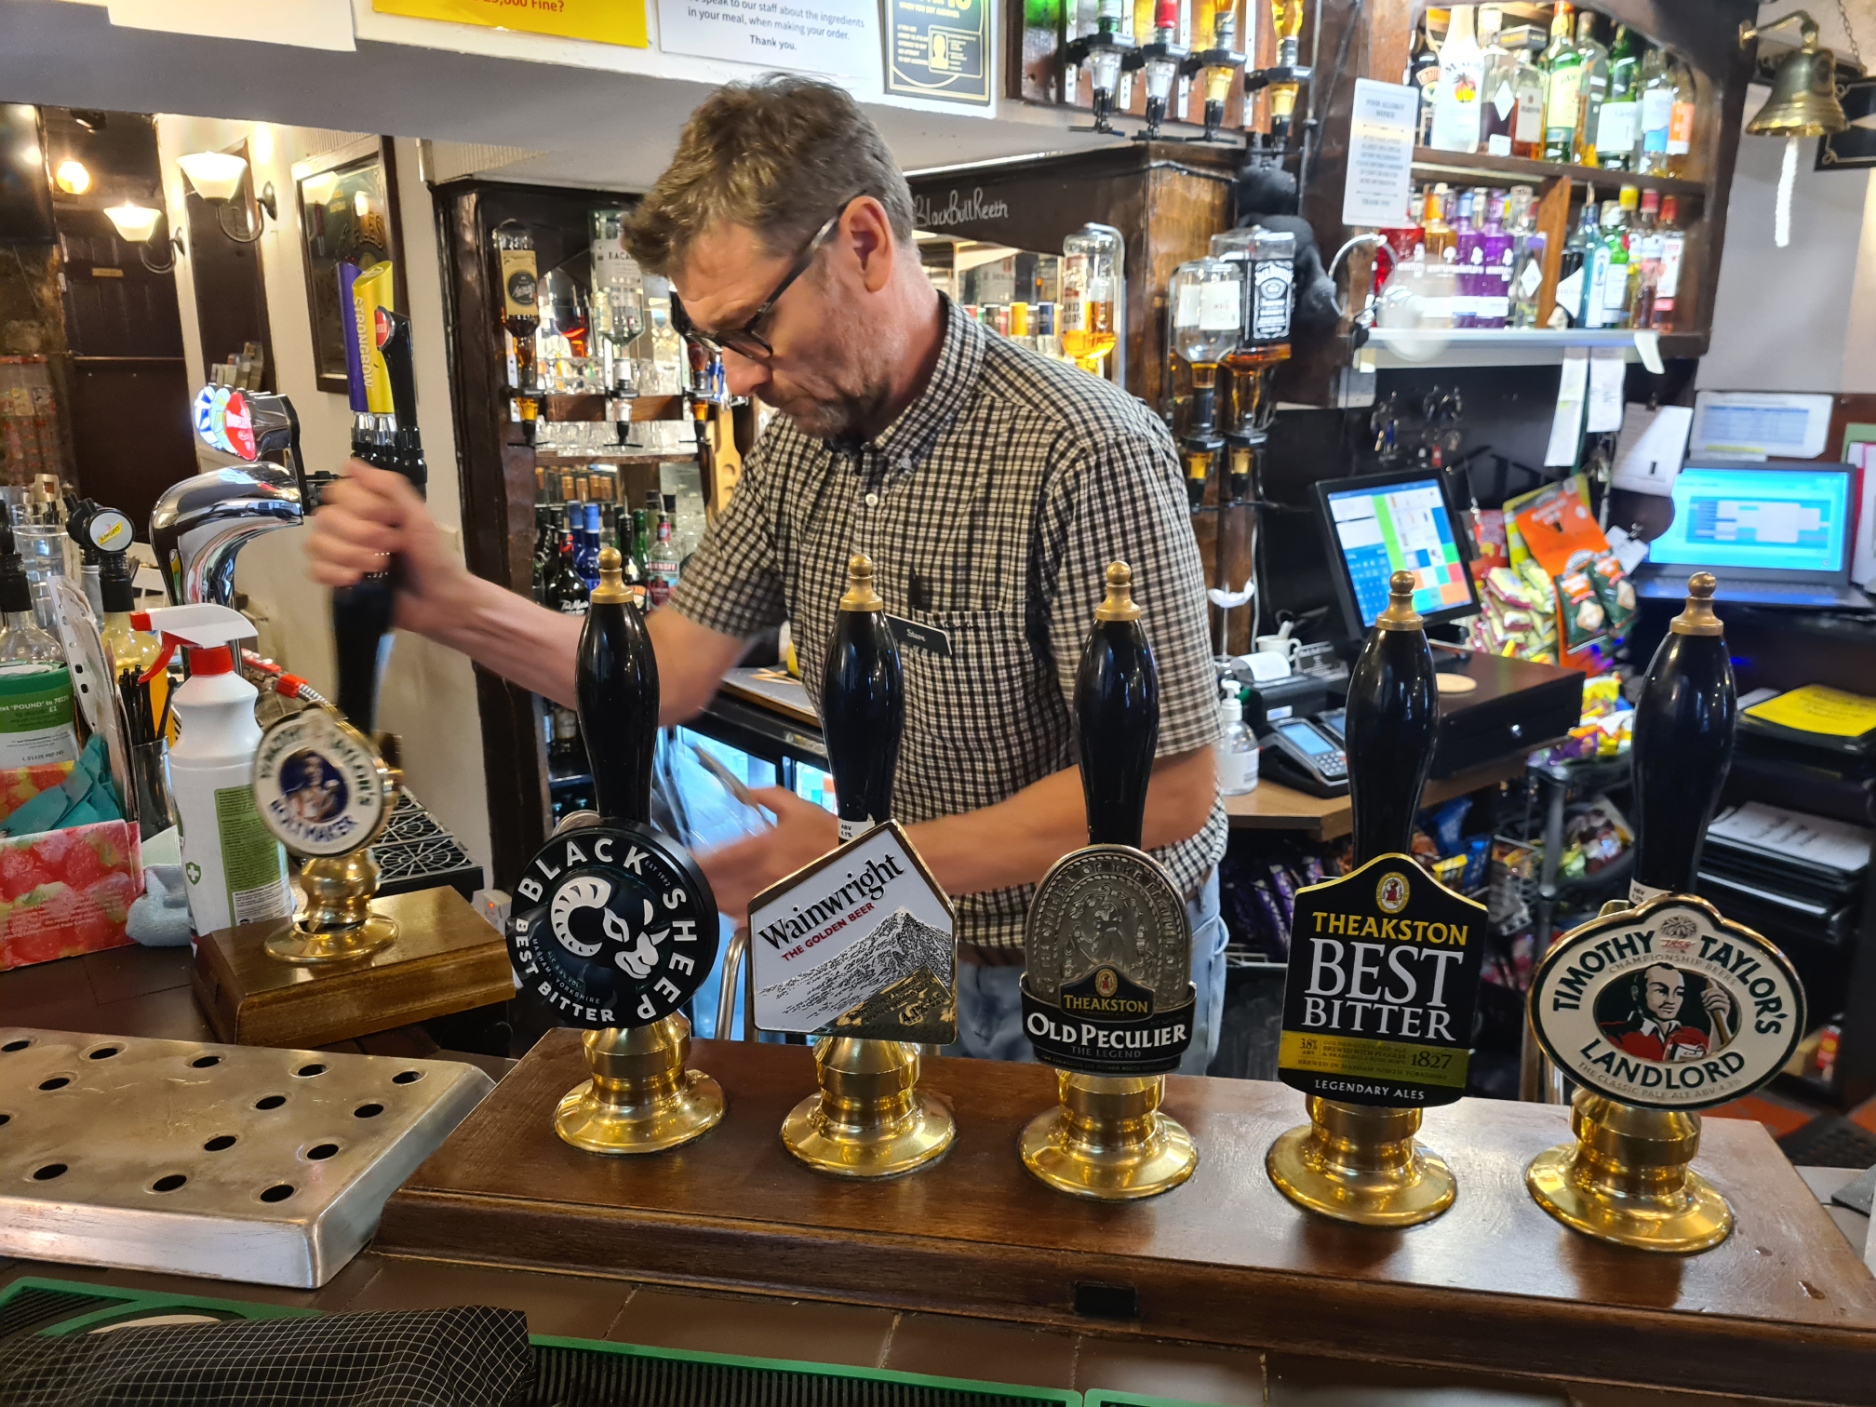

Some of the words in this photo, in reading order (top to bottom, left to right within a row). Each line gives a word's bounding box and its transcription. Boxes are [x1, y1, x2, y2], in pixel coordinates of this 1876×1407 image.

[531, 0, 565, 12] Fine?
[687, 6, 697, 17] in
[699, 10, 720, 21] your
[722, 13, 747, 26] meal,
[748, 17, 773, 28] when
[774, 21, 806, 36] making
[806, 26, 825, 37] your
[826, 28, 850, 40] order.
[742, 1, 757, 10] our
[758, 2, 777, 13] staff
[779, 6, 803, 18] about
[805, 9, 819, 21] the
[820, 12, 865, 28] ingredients
[749, 34, 777, 47] Thank
[778, 38, 797, 51] you.
[352, 296, 374, 389] STRONGBOW
[645, 859, 659, 872] EST
[657, 870, 671, 887] 1992
[1082, 862, 1102, 875] OF
[1112, 864, 1143, 880] THE
[758, 853, 905, 951] Wainwright
[517, 838, 650, 902] BLACK
[637, 888, 698, 1020] SHEEP
[781, 946, 805, 962] THE
[805, 918, 848, 949] GOLDEN
[849, 902, 875, 922] BEER
[1312, 911, 1469, 946] THEAKSTON
[515, 918, 539, 975] BEST
[537, 980, 616, 1023] BITTER
[1304, 937, 1464, 1008] BEST
[1553, 930, 1656, 1013] TIMOTHY
[1697, 935, 1788, 1035] TAYLOR'S
[1608, 953, 1703, 974] CHAMPIONSHIP
[1704, 960, 1737, 986] BEERS
[555, 978, 600, 1005] YORKSHIRE
[1064, 995, 1148, 1013] THEAKSTON
[1027, 1012, 1077, 1043] OLD
[1081, 1023, 1187, 1049] PECULIER
[1301, 996, 1456, 1041] BITTER
[1071, 1046, 1092, 1057] THE
[1096, 1046, 1141, 1058] LEGEND
[1412, 1051, 1453, 1070] 1827
[1580, 1038, 1745, 1090] LANDLORD
[1315, 1079, 1390, 1096] LEGENDARY
[1393, 1088, 1425, 1100] ALES
[1578, 1061, 1597, 1078] THE
[1597, 1072, 1638, 1096] CLASSIC
[1642, 1089, 1667, 1099] PALE
[1671, 1089, 1690, 1099] ALE
[1694, 1085, 1716, 1097] ABV
